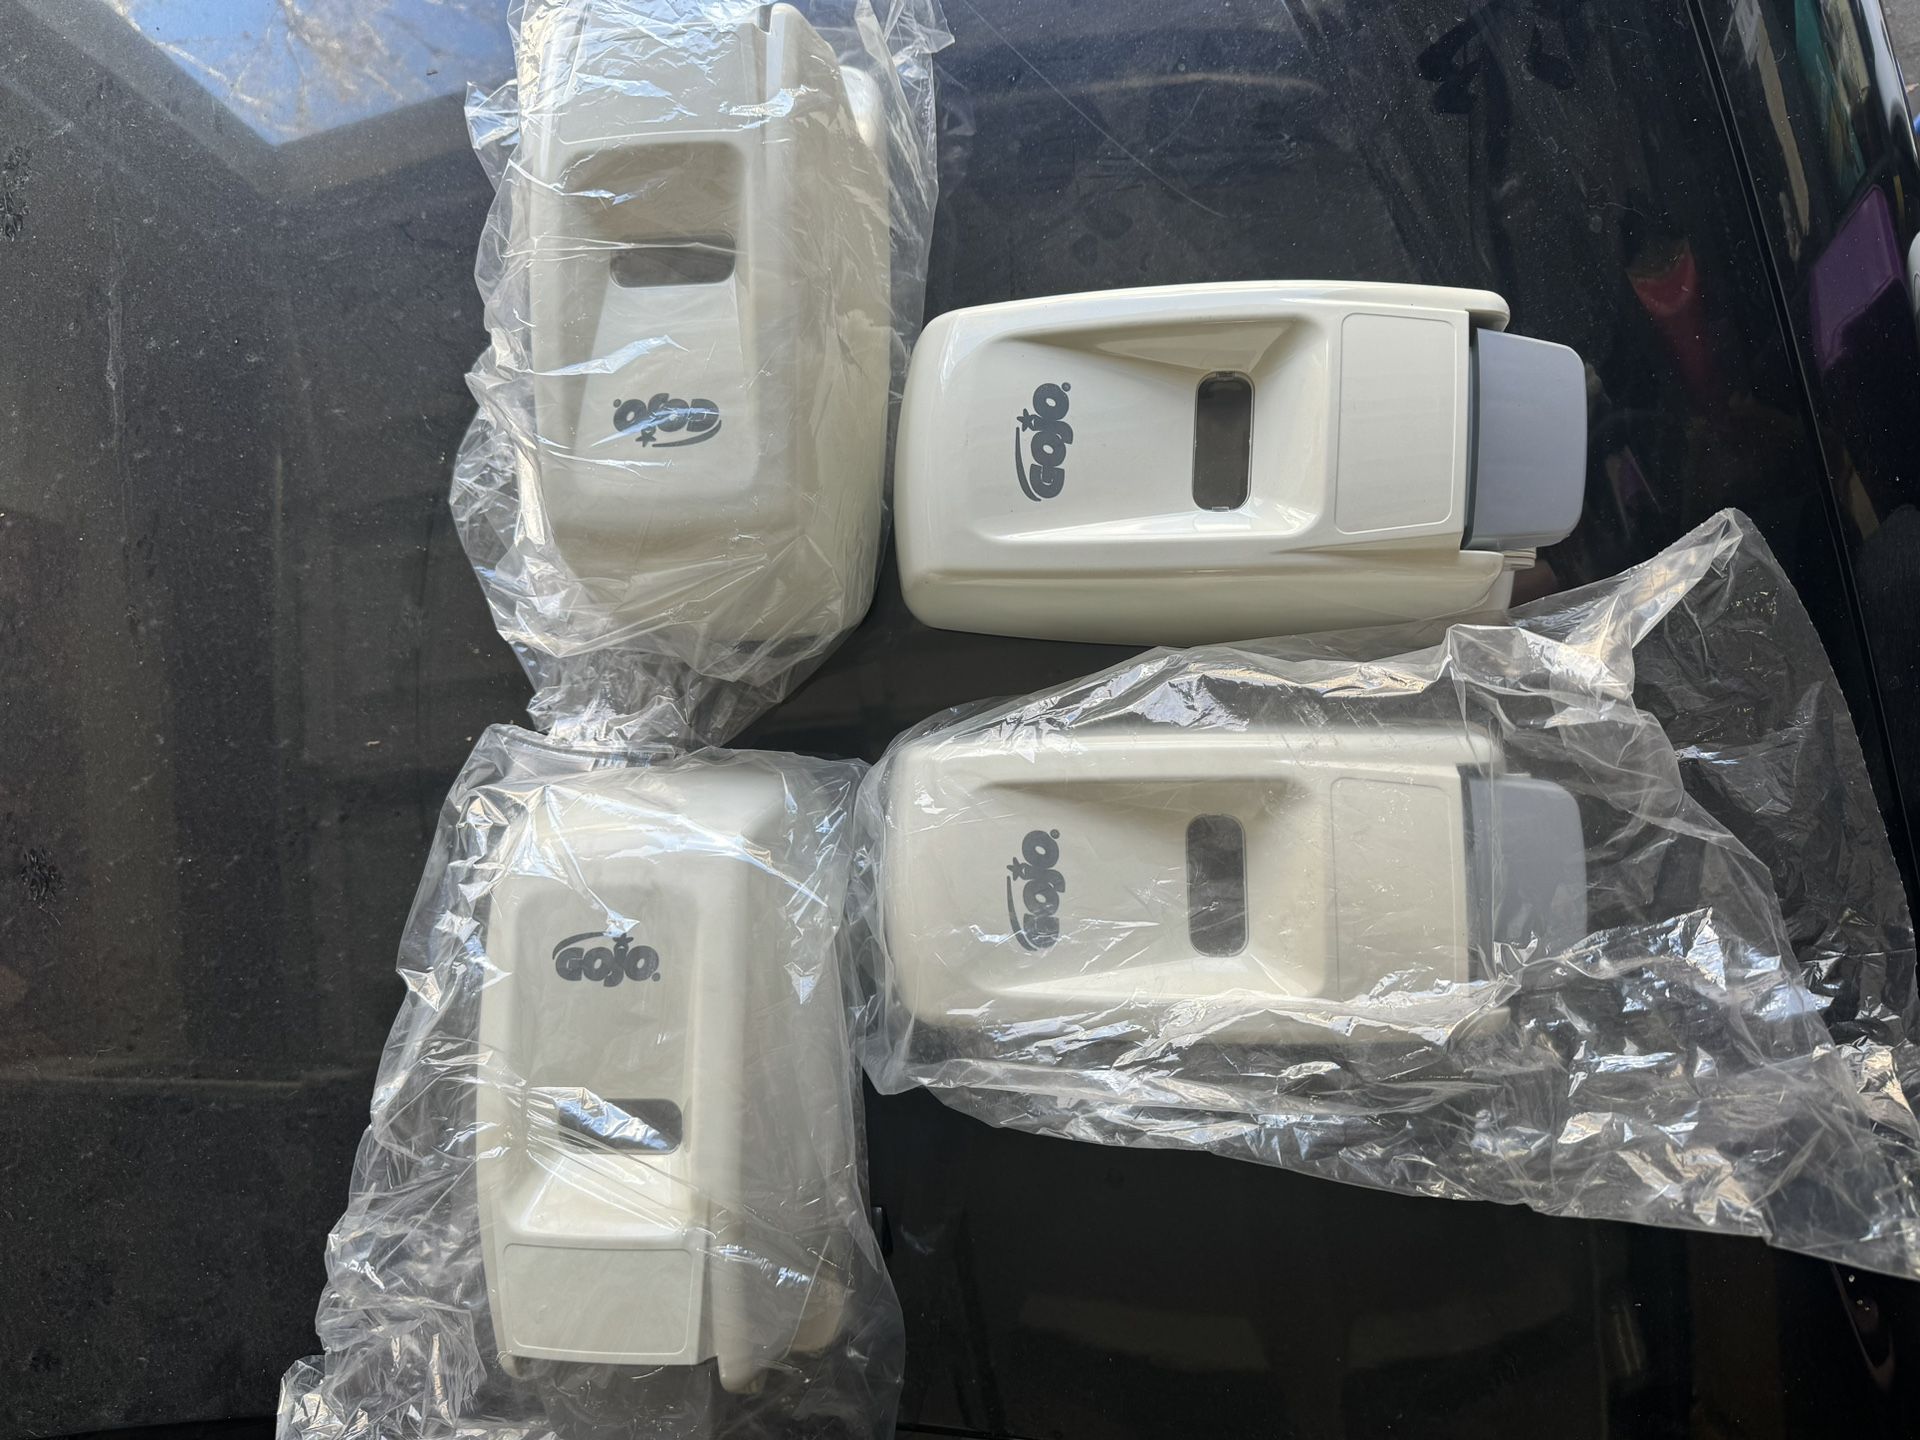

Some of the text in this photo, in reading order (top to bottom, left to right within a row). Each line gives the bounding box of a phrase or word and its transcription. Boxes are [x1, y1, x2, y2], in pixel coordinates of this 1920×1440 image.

[1028, 382, 1073, 499] GOJO
[1021, 829, 1066, 949] GOJO
[555, 941, 660, 987] GOJO
